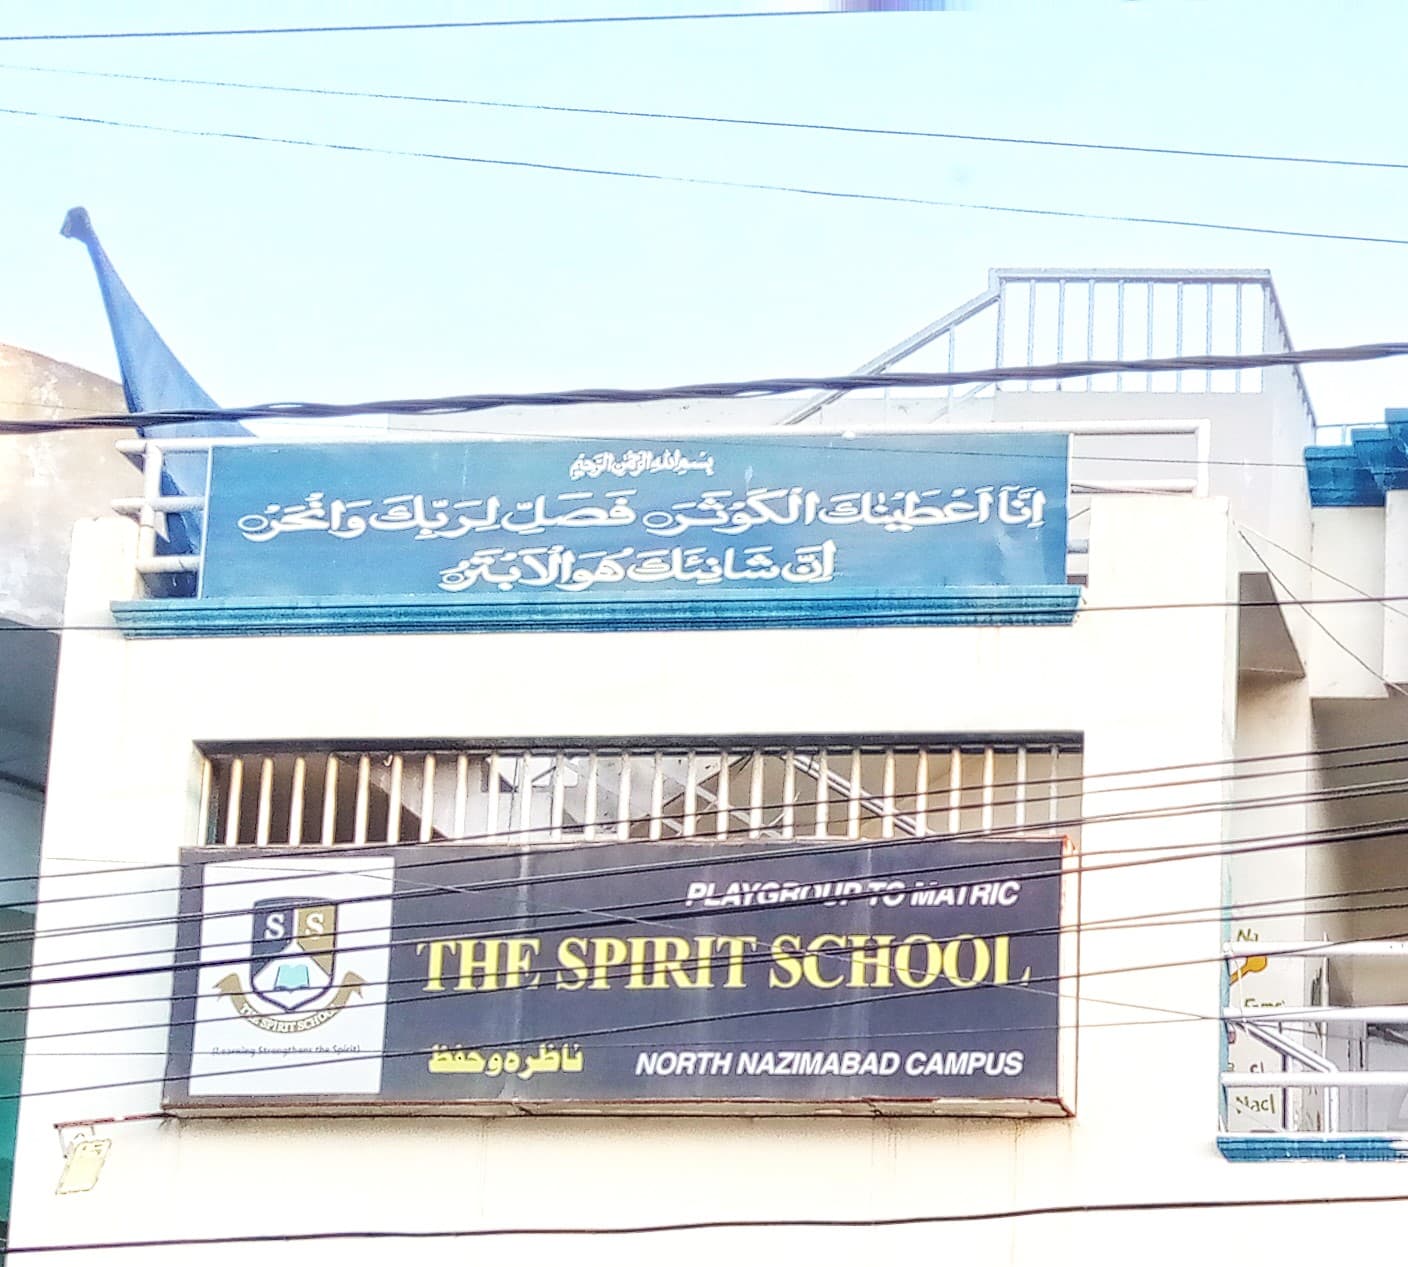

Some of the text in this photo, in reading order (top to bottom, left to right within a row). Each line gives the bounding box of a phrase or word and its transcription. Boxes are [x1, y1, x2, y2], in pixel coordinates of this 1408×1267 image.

[868, 881, 906, 907] TO
[416, 934, 1031, 991] THE SPIRIT SCHOOL
[635, 1050, 1025, 1076] NORTH NAZIMABAD CAMPUS
